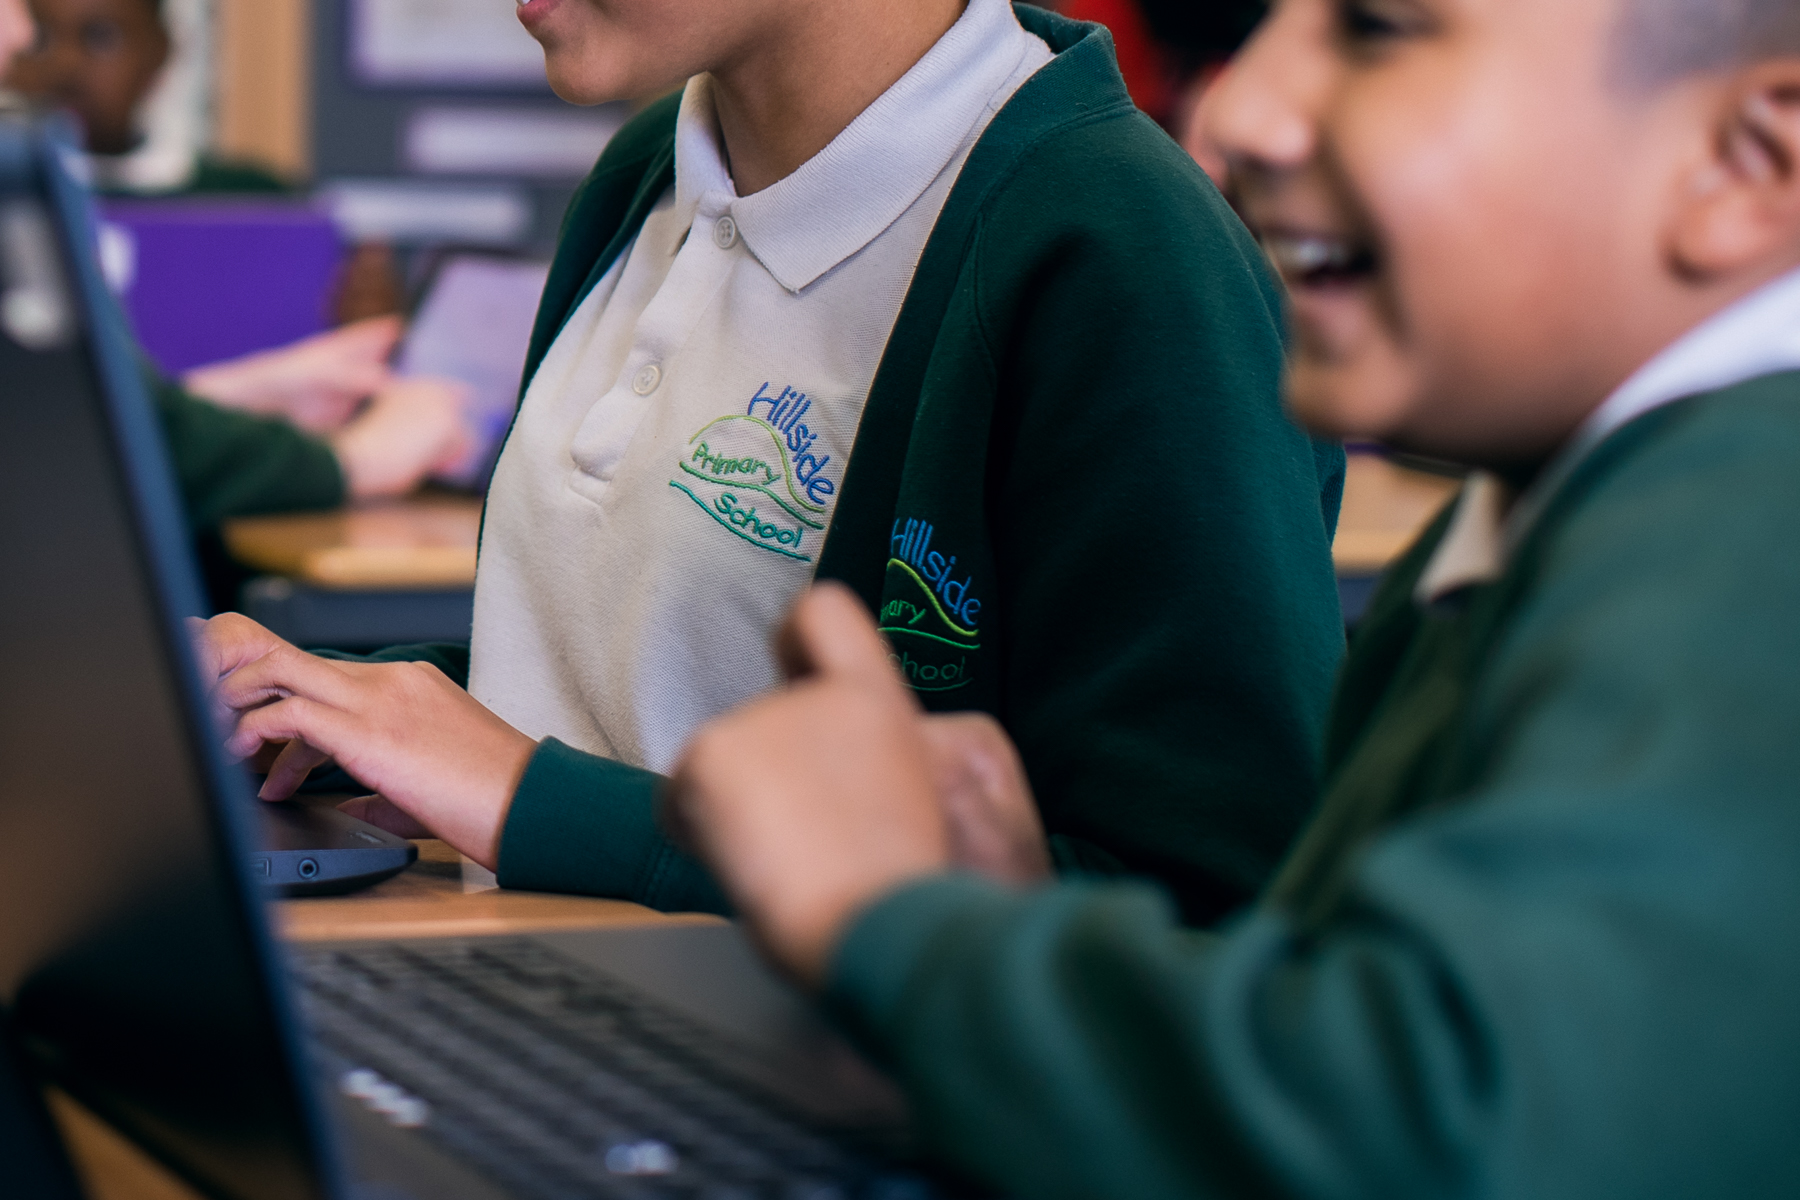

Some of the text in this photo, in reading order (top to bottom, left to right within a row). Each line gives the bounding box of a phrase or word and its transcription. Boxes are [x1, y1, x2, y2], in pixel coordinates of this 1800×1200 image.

[691, 440, 782, 485] Primary
[747, 381, 834, 505] Hillside
[713, 492, 804, 548] School
[890, 517, 981, 626] Hillside
